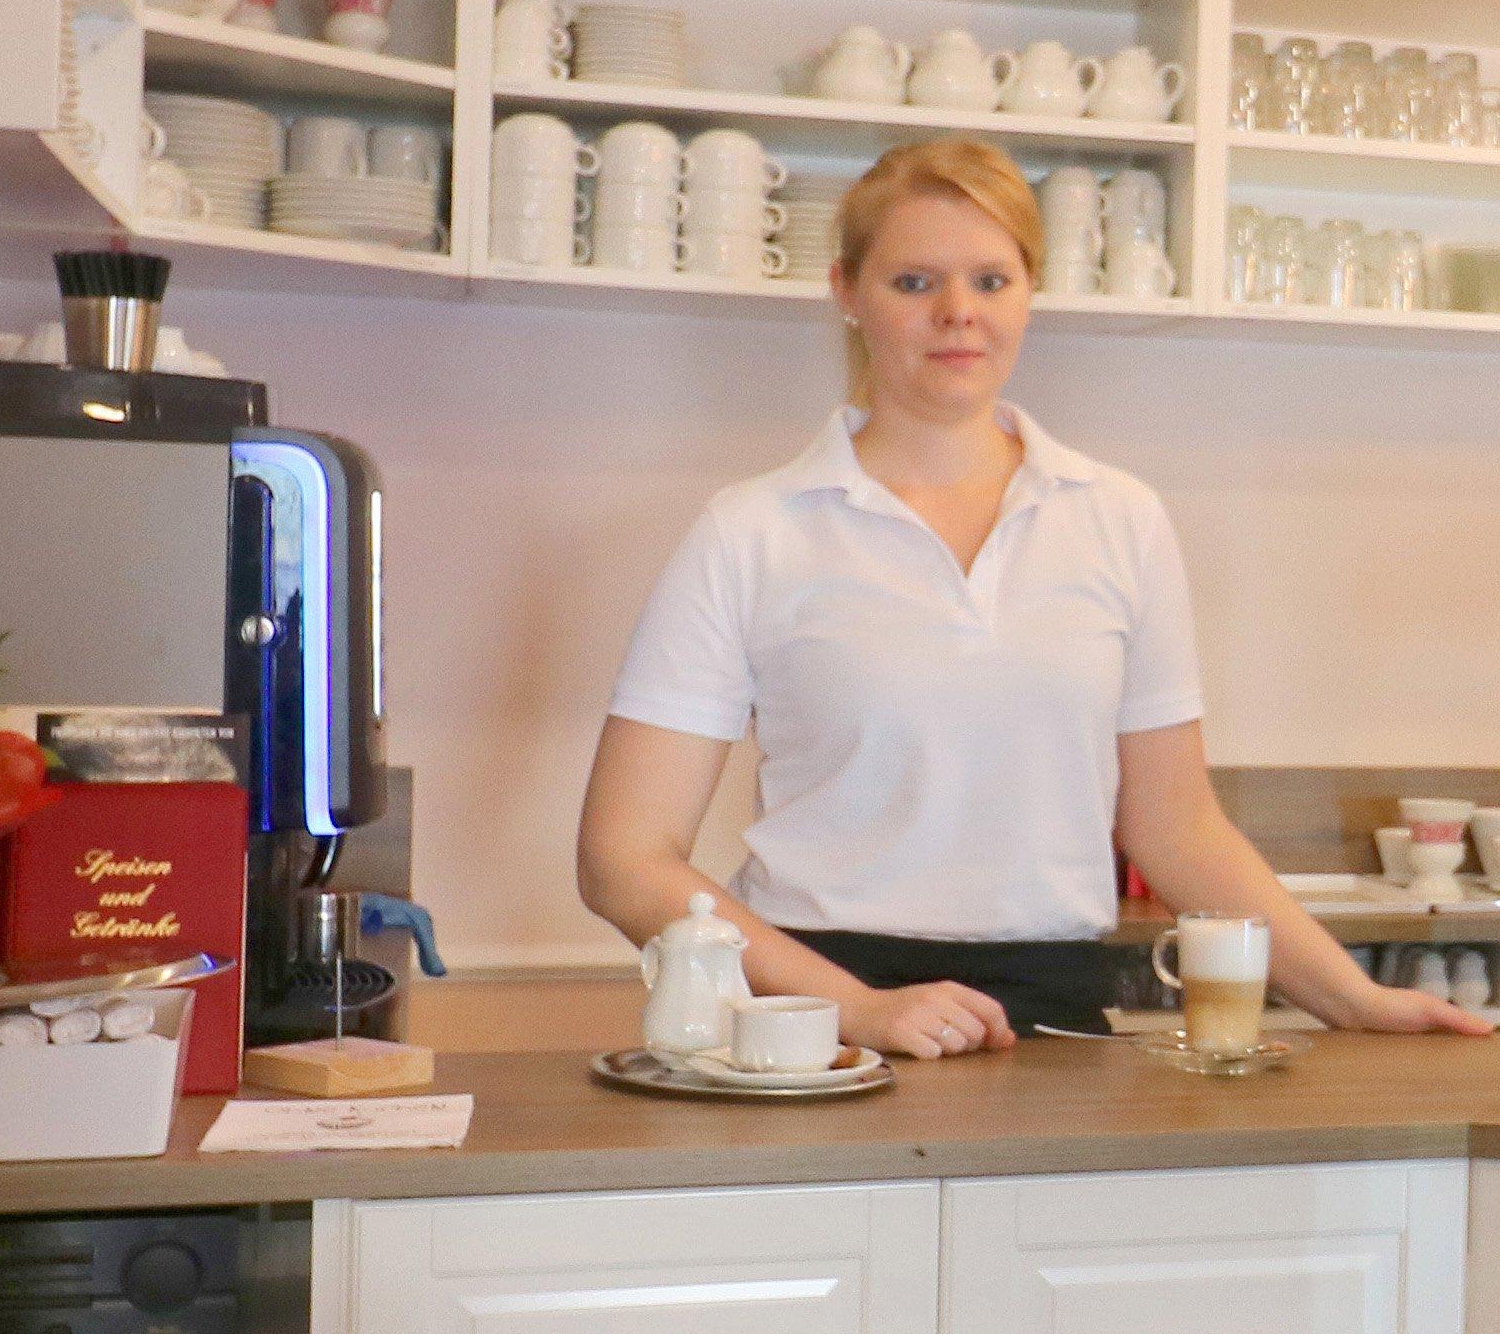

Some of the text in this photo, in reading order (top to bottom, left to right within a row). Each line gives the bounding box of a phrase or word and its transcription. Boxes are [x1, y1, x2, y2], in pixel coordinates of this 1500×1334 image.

[74, 848, 173, 884] Speisen
[99, 882, 157, 908] und
[69, 910, 182, 939] Getränke
